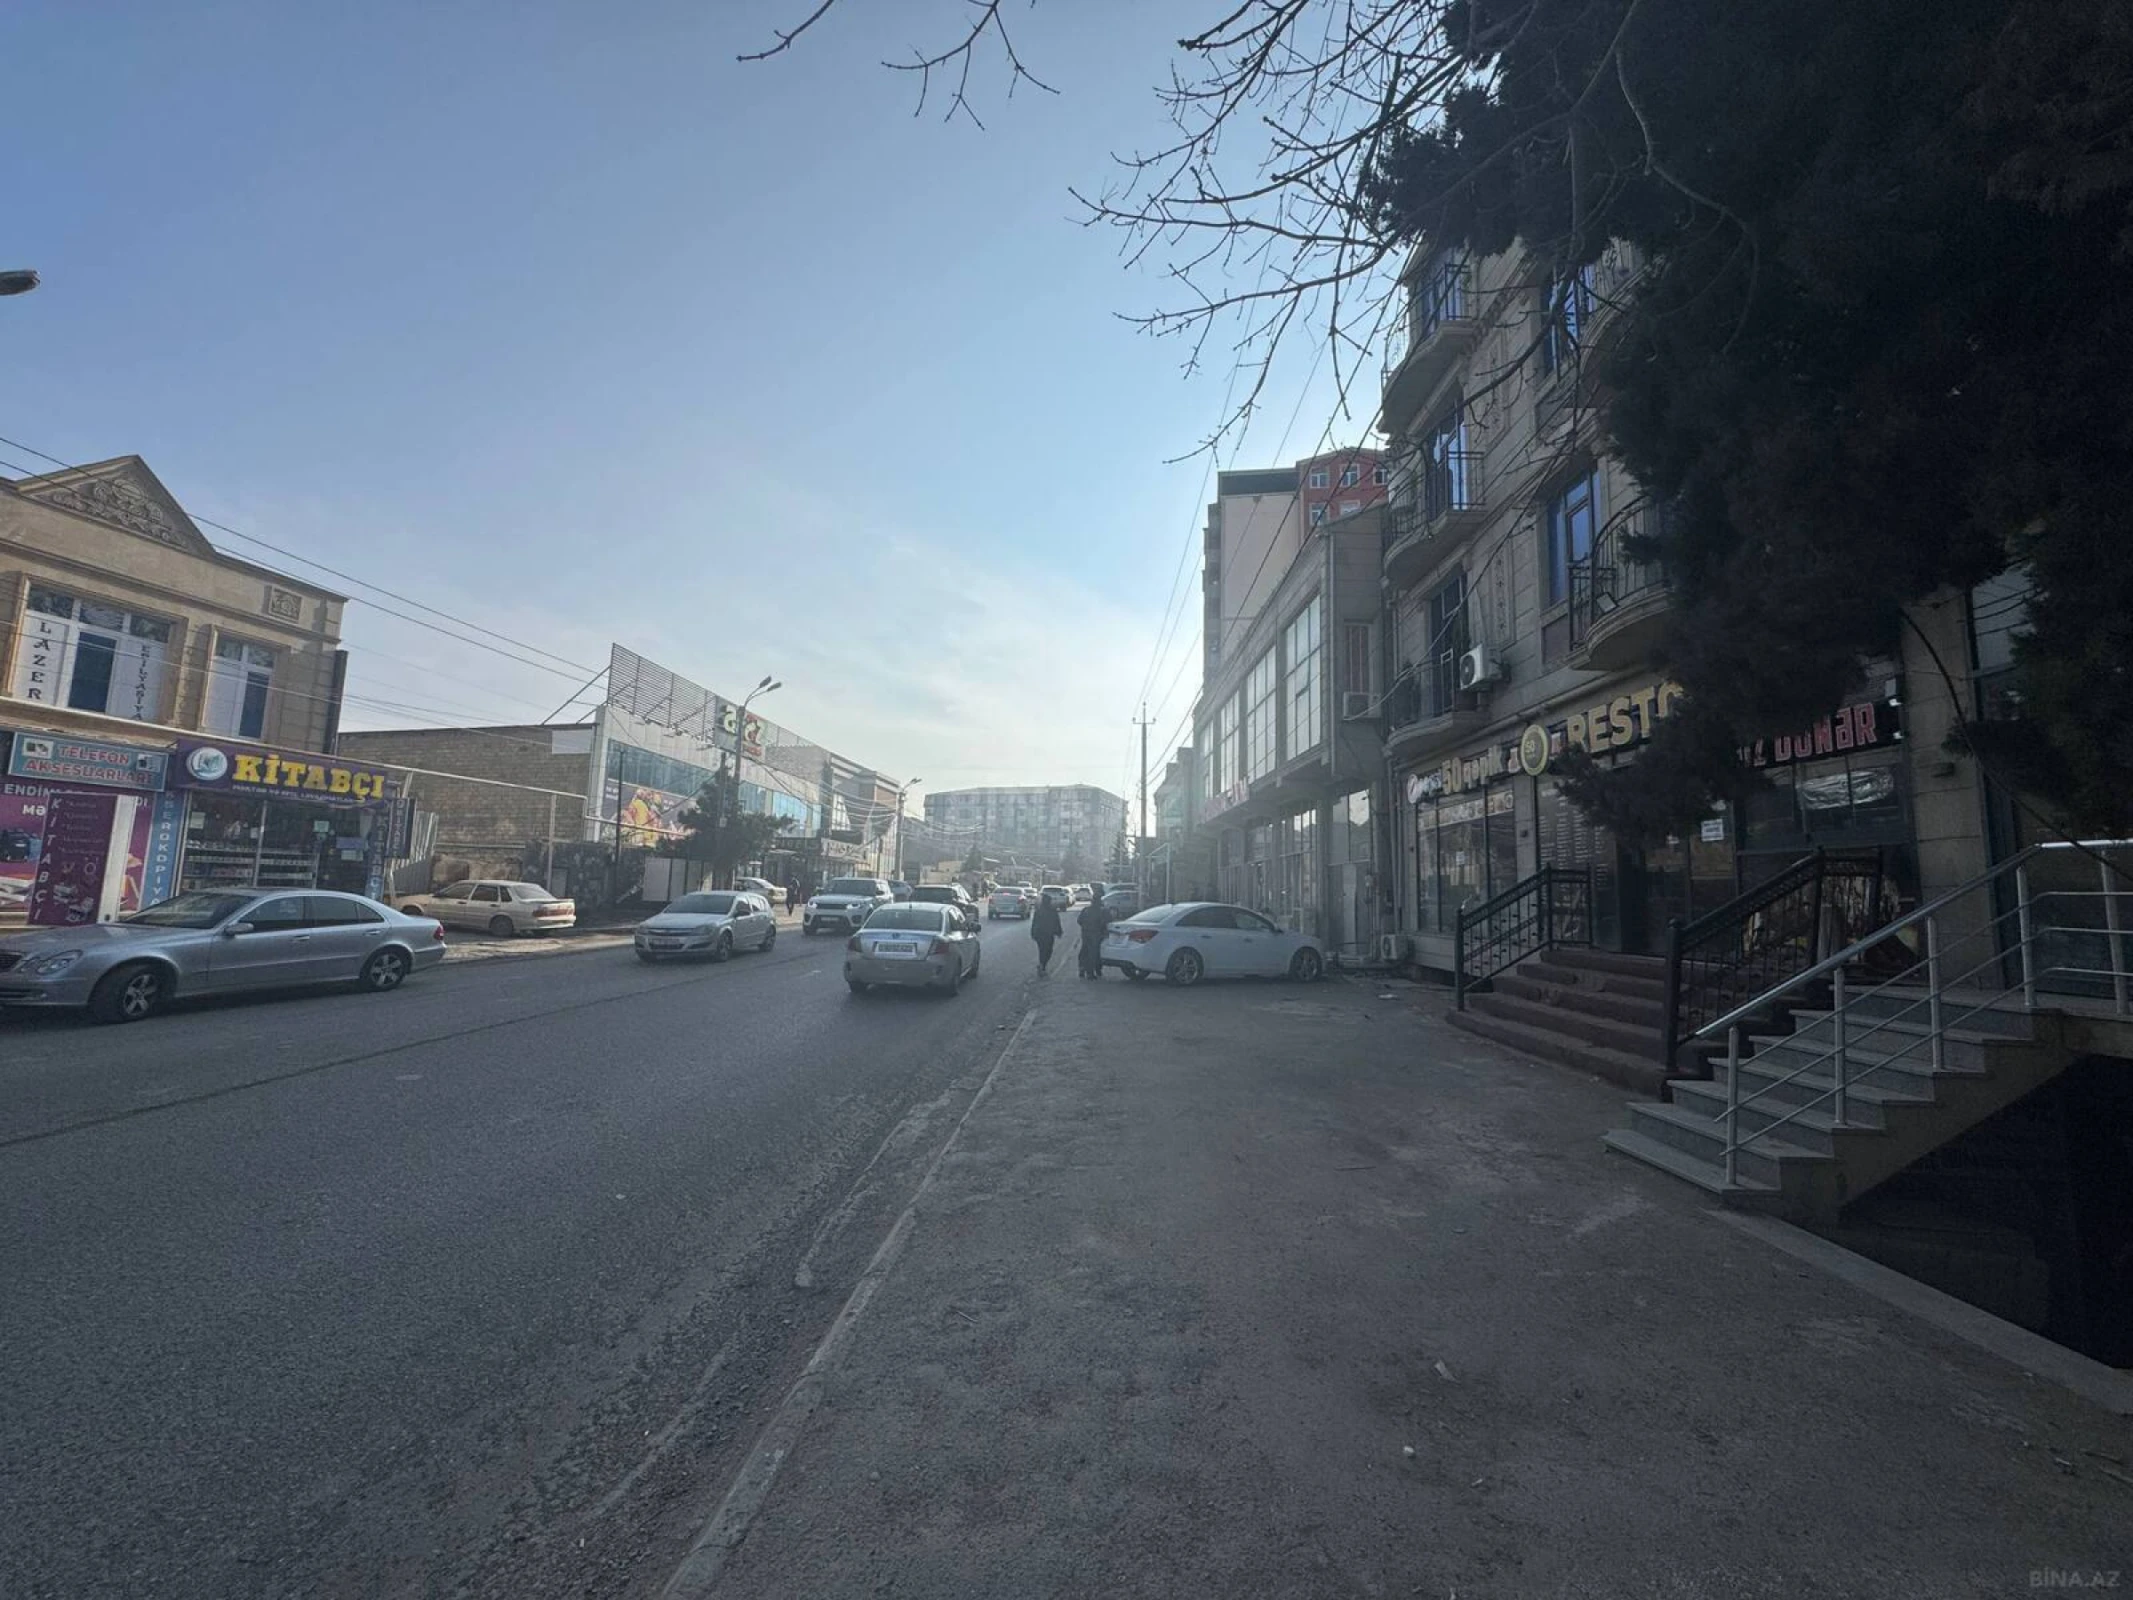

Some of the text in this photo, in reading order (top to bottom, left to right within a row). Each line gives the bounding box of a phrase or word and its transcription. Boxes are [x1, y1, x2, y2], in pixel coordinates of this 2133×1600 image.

[27, 621, 51, 700] LAZER
[24, 758, 153, 783] AKSESUARLARI
[58, 744, 130, 764] TELEFON
[232, 753, 385, 804] KİTABÇI
[1442, 757, 1462, 795] 50
